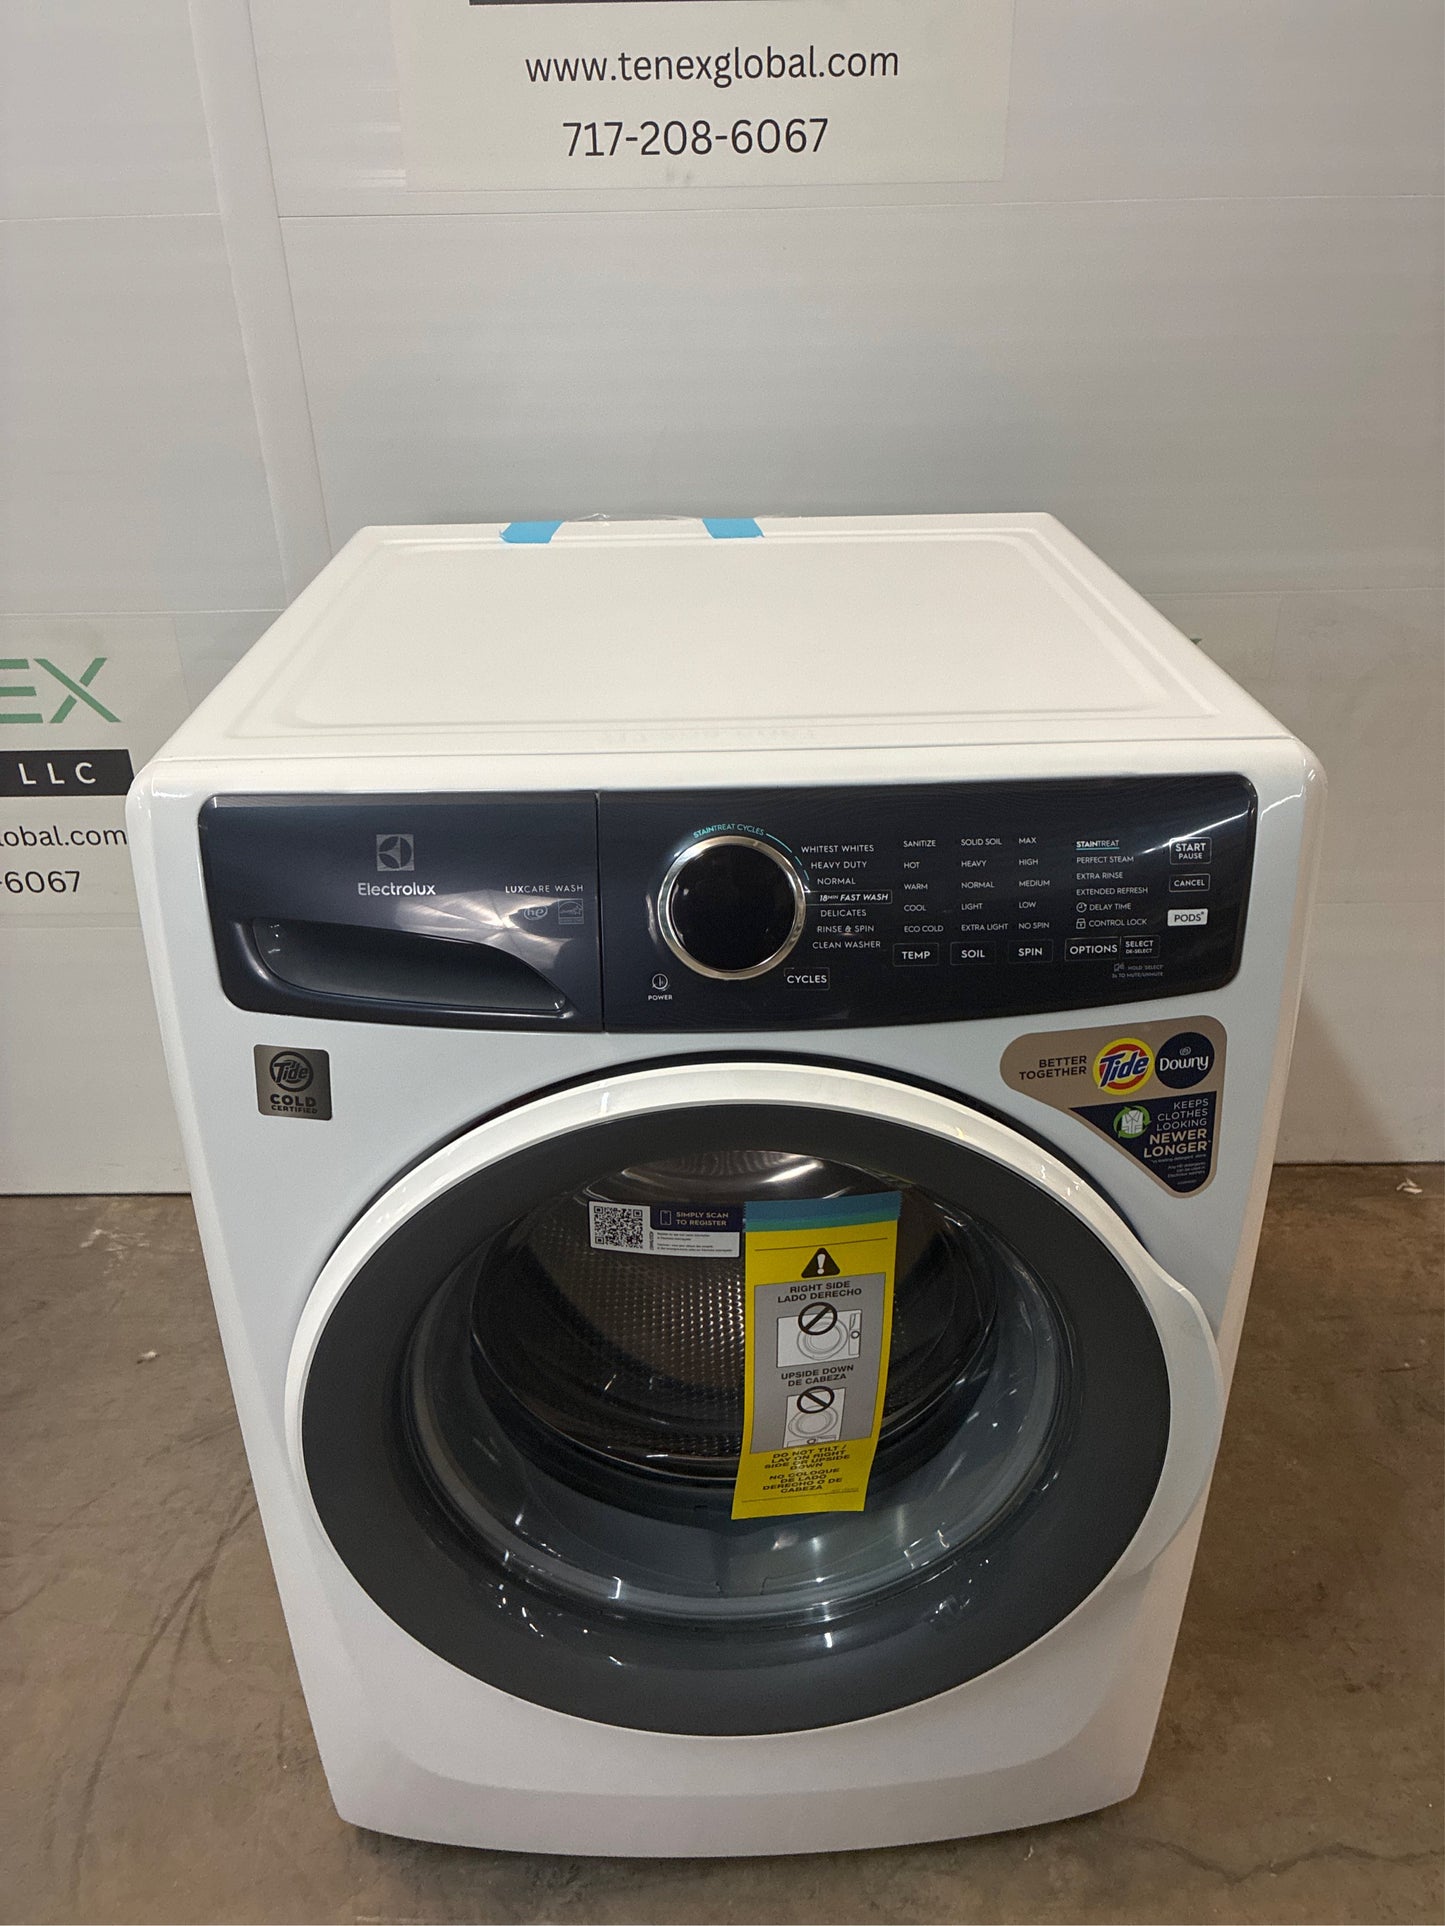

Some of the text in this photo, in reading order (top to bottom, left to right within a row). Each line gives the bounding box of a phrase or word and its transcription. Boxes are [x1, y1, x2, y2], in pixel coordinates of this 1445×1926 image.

[525, 46, 899, 88] www.tenexglobal.com
[562, 118, 829, 157] 717-208-6067
[18, 761, 97, 785] LLC
[693, 823, 765, 839] STAINTREAT CYCLES
[903, 839, 937, 848] SANITIZE
[961, 837, 1002, 846] SOLID SOIL
[1018, 836, 1037, 844] MAX
[1076, 839, 1120, 848] STAINTREAT
[801, 844, 875, 853] WHITEST WHITES
[1175, 842, 1207, 852] START
[1076, 855, 1134, 864] PERFECT STEAM
[1178, 852, 1203, 860] PAUSE
[810, 861, 868, 870] HEAVY DUTY
[903, 861, 921, 869] HOT
[961, 860, 987, 868] HEAVY
[1018, 858, 1039, 866] HIGH
[1076, 871, 1124, 880] EXTRA RINSE
[0, 870, 80, 894] 6067
[817, 877, 856, 885] NORMAL
[961, 881, 995, 889] NORMAL
[357, 882, 437, 897] Electrolux
[505, 884, 584, 894] LUXCARE WASH
[1076, 887, 1149, 896] EXTENDED REFRESH
[840, 894, 861, 902] FAST
[863, 893, 889, 901] WASH
[903, 904, 927, 912] COOL
[961, 903, 983, 911] LIGHT
[1089, 902, 1132, 911] DELAY TIME
[820, 909, 867, 917] DELICATES
[1018, 921, 1050, 930] NO SPIN
[1089, 918, 1148, 927] CONTROL LOCK
[817, 925, 842, 933] RINSE
[904, 925, 944, 933] ECO COLD
[961, 923, 1009, 932] EXTRA LIGHT
[812, 940, 881, 949] CLEAN WASHER
[1125, 940, 1154, 948] SELECT
[1018, 948, 1043, 957] SPIN
[1069, 944, 1118, 955] OPTIONS
[902, 951, 931, 960] TEMP
[961, 950, 986, 959] SOIL
[786, 974, 827, 984] CYCLES
[1038, 1055, 1087, 1068] BETTER
[1159, 1056, 1209, 1072] Downy
[274, 1060, 308, 1083] Tide
[1019, 1066, 1087, 1080] TOGETHER
[1099, 1050, 1150, 1088] Tide
[270, 1093, 317, 1107] COLD
[1173, 1098, 1209, 1110] KEEPS
[271, 1104, 319, 1114] CERTIFIED
[1157, 1108, 1208, 1121] CLOTHES
[1156, 1118, 1207, 1131] LOOKING
[1149, 1128, 1207, 1145] NEWER
[790, 1281, 850, 1293] RIGHT SIDE
[777, 1288, 862, 1303] LADO DERECHO
[781, 1365, 854, 1380] UPSIDE DOWN
[805, 1374, 847, 1385] CABEZA
[811, 1454, 850, 1463] UPSIDE
[813, 1450, 846, 1458] RIGHT
[780, 1485, 823, 1493] CABEZA
